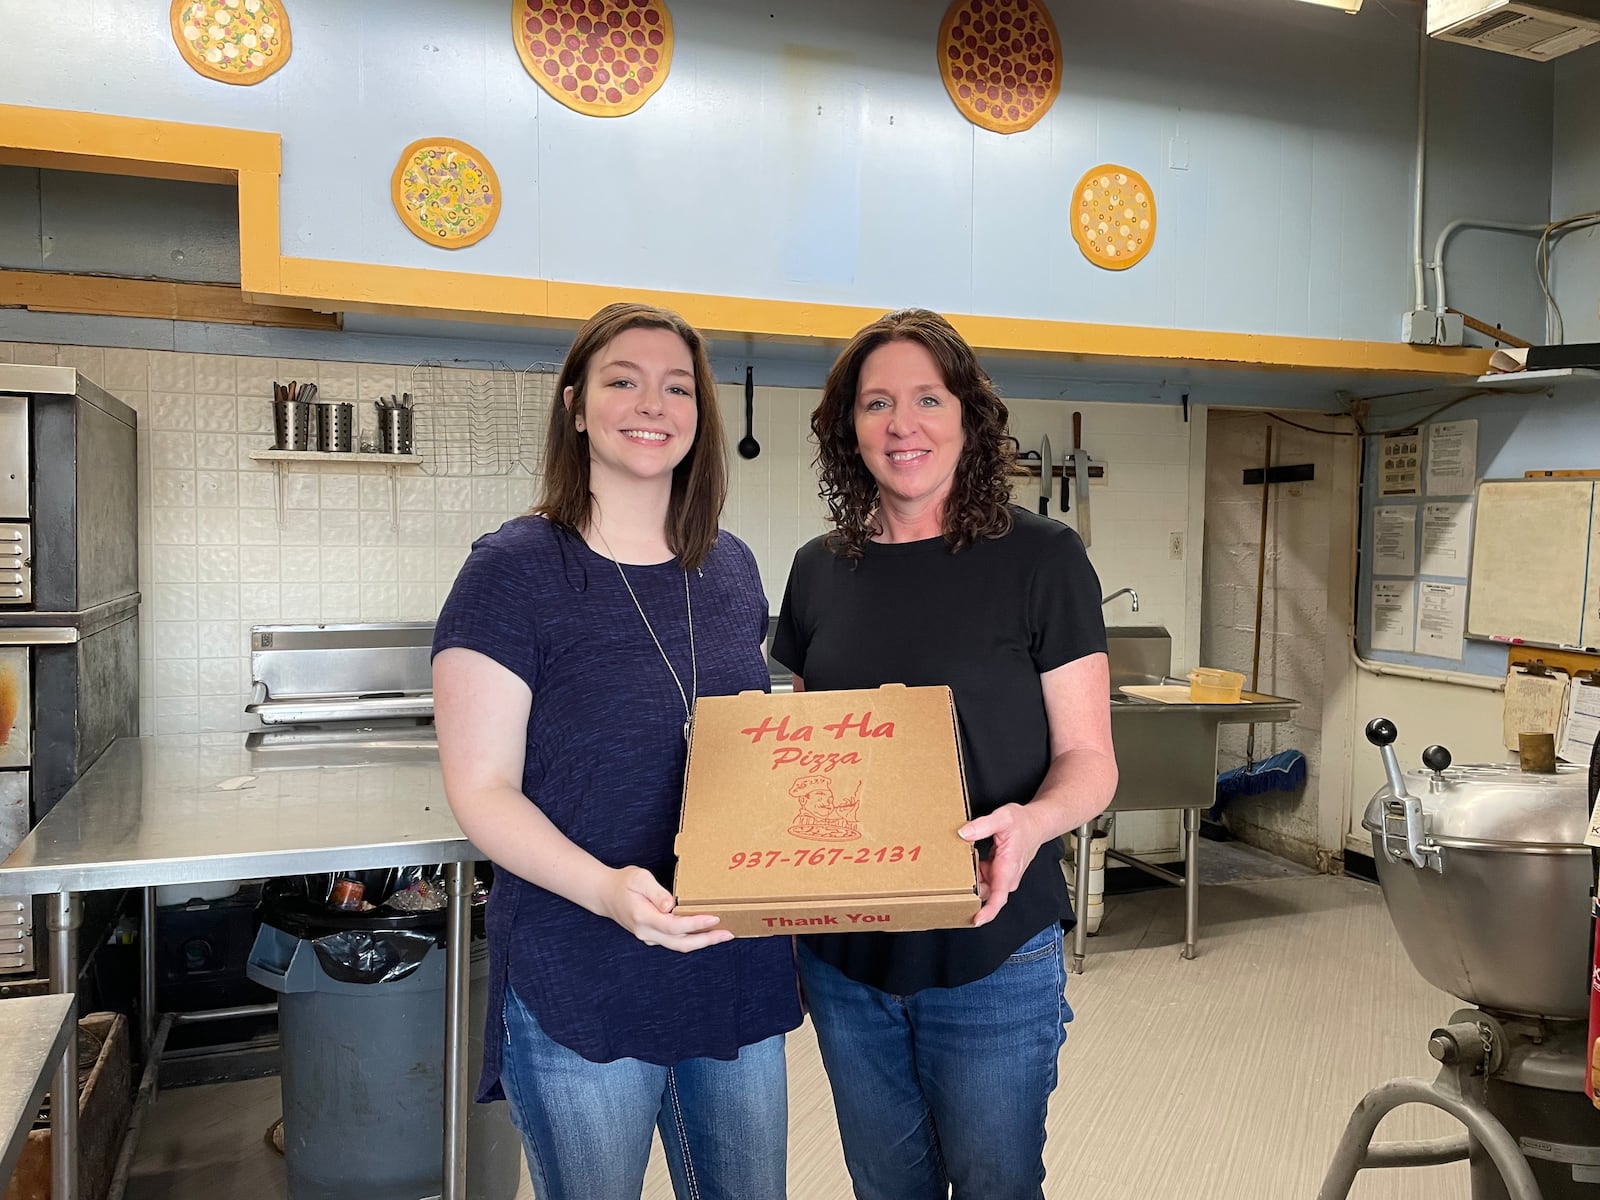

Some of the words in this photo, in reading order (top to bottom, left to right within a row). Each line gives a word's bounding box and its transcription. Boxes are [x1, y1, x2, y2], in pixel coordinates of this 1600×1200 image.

[741, 715, 814, 743] Ha
[823, 711, 896, 740] Ha
[771, 747, 863, 773] Pizza
[728, 845, 922, 870] 937-767-2131
[762, 914, 839, 929] Thank
[846, 912, 892, 925] You
